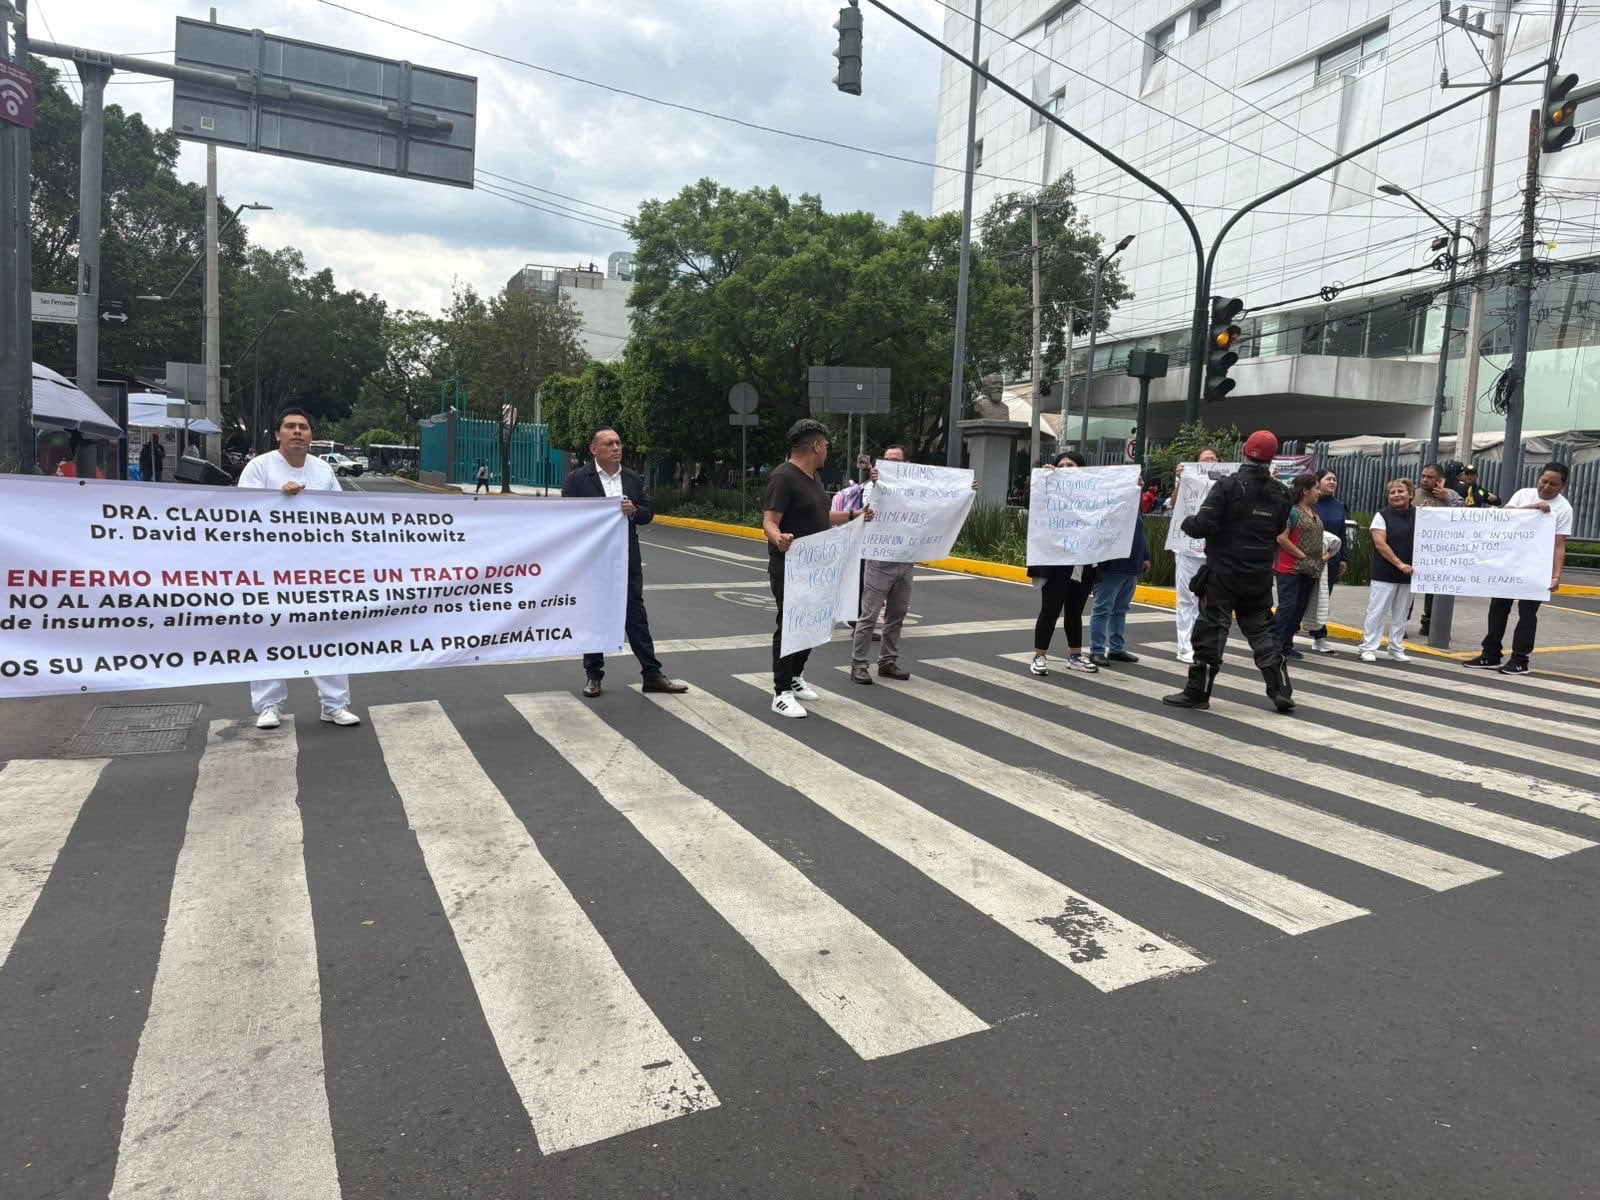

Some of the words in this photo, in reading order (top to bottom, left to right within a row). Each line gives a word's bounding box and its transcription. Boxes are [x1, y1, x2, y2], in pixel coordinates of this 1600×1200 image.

[52, 299, 76, 307] Fernando
[103, 504, 157, 520] DRA.
[166, 507, 262, 522] CLAUDIA
[270, 511, 384, 524] SHEINBAUM
[392, 513, 453, 525] PARDO
[1450, 509, 1511, 522] EXIGIMOS
[91, 525, 123, 539] Dr.
[133, 526, 195, 541] David
[205, 528, 344, 542] Kershenobich
[352, 529, 465, 542] Stalnikowitz
[1473, 530, 1483, 539] DE
[1489, 530, 1536, 540] INSUMOS
[872, 547, 897, 557] BASE
[8, 570, 150, 587] ENFERMO
[162, 571, 264, 586] MENTAL
[274, 570, 365, 585] MERECE
[374, 569, 402, 582] UN
[410, 567, 478, 581] TRATO
[485, 564, 541, 578] DIGNO
[1417, 574, 1467, 583] LIBERACION
[1471, 575, 1482, 583] DE
[1487, 576, 1524, 584] PLAZAS
[10, 594, 47, 608] NO
[58, 595, 89, 608] AL
[99, 593, 234, 608] ABANDONO
[243, 592, 269, 605] DE
[277, 589, 379, 604] NUESTRAS
[387, 583, 513, 601] INSTITUCIONES
[0, 615, 31, 629] de
[43, 614, 153, 629] insumos,
[164, 612, 263, 626] alimento
[270, 614, 281, 626] y
[289, 605, 427, 623] mantenimiento
[434, 603, 462, 613] nos
[469, 599, 512, 611] tiene
[519, 601, 536, 609] en
[541, 595, 576, 607] crisis
[50, 658, 82, 674] SU
[95, 653, 183, 671] APOYO
[194, 649, 258, 665] PARA
[267, 640, 402, 661] SOLUCIONAR
[411, 639, 433, 651] LA
[442, 627, 572, 649] PROBLEMÁTICA
